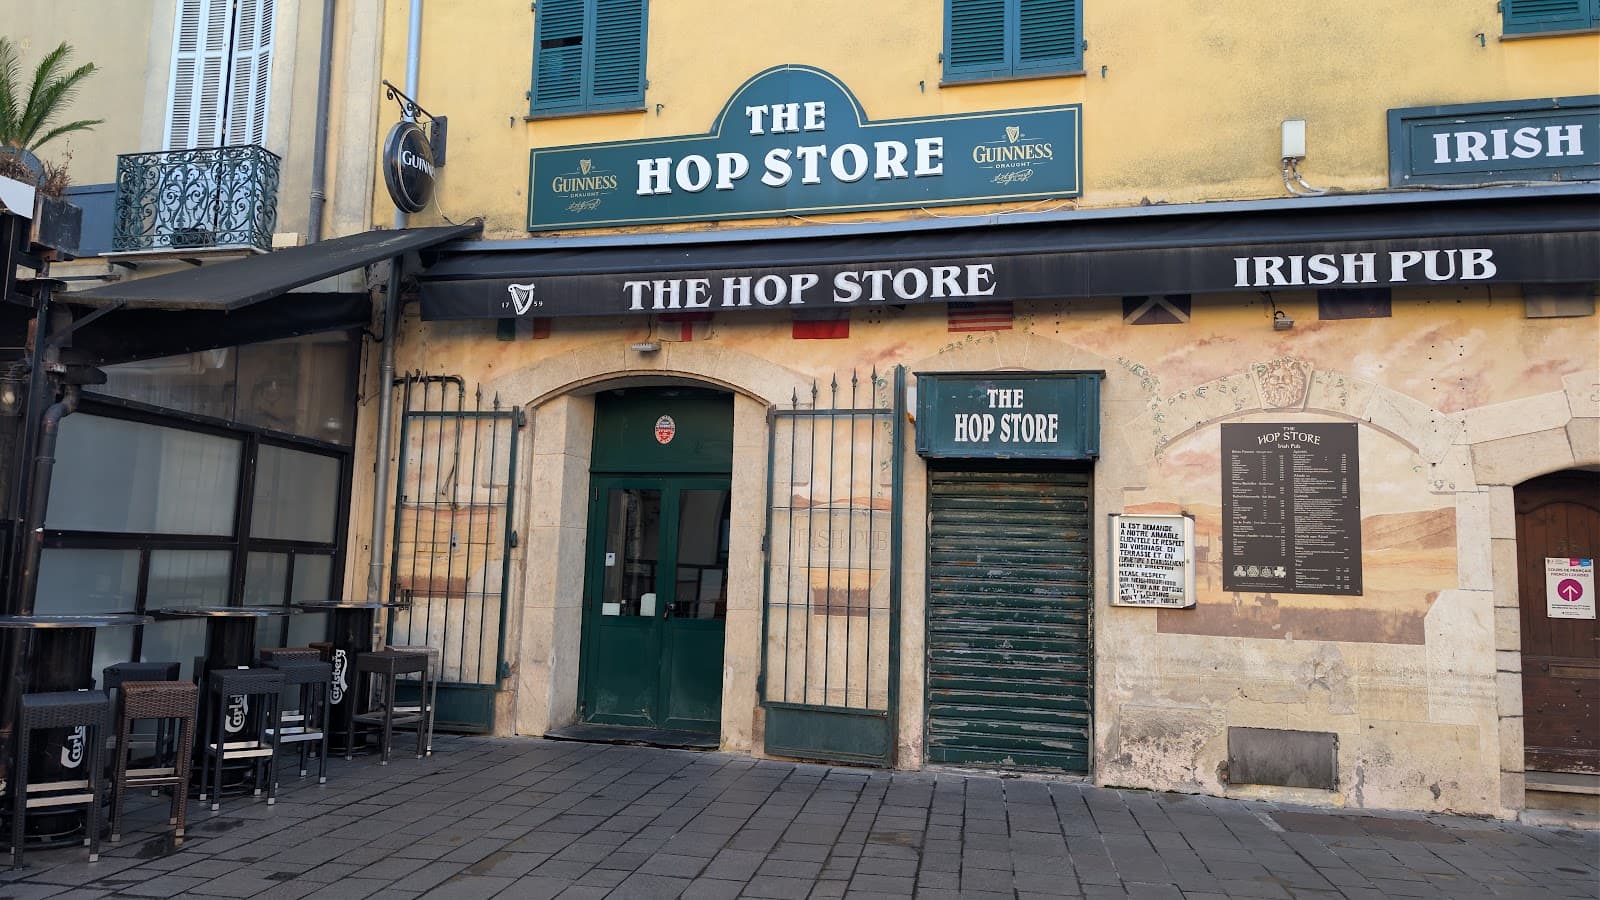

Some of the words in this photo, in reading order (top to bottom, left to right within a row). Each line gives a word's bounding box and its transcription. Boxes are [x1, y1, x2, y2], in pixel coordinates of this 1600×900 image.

[745, 101, 826, 136] THE
[973, 143, 1053, 163] GUINNESS
[1432, 124, 1584, 164] IRISH
[636, 152, 750, 196] HOP
[760, 136, 944, 188] STORE
[552, 174, 617, 194] GUINNESS
[570, 191, 600, 199] DRAUGHT
[1233, 252, 1378, 287] IRISH
[1388, 248, 1497, 282] PUB
[622, 278, 712, 311] THE
[720, 273, 820, 307] HOP
[833, 263, 997, 302] STORE
[987, 389, 1024, 409] THE
[954, 413, 995, 443] HOP
[1000, 413, 1058, 443] STORE
[1257, 432, 1281, 445] HOP
[1283, 431, 1321, 445] STORE
[1126, 530, 1148, 538] NOTRE
[1142, 524, 1173, 532] DEMANDE
[1120, 536, 1151, 544] CLIENTELE
[1130, 544, 1163, 552] VOISINAGE
[1120, 549, 1151, 557] TERRASSE
[1145, 590, 1170, 598] CLOSING
[330, 649, 348, 705] Carlsberg
[225, 694, 248, 733] Carls
